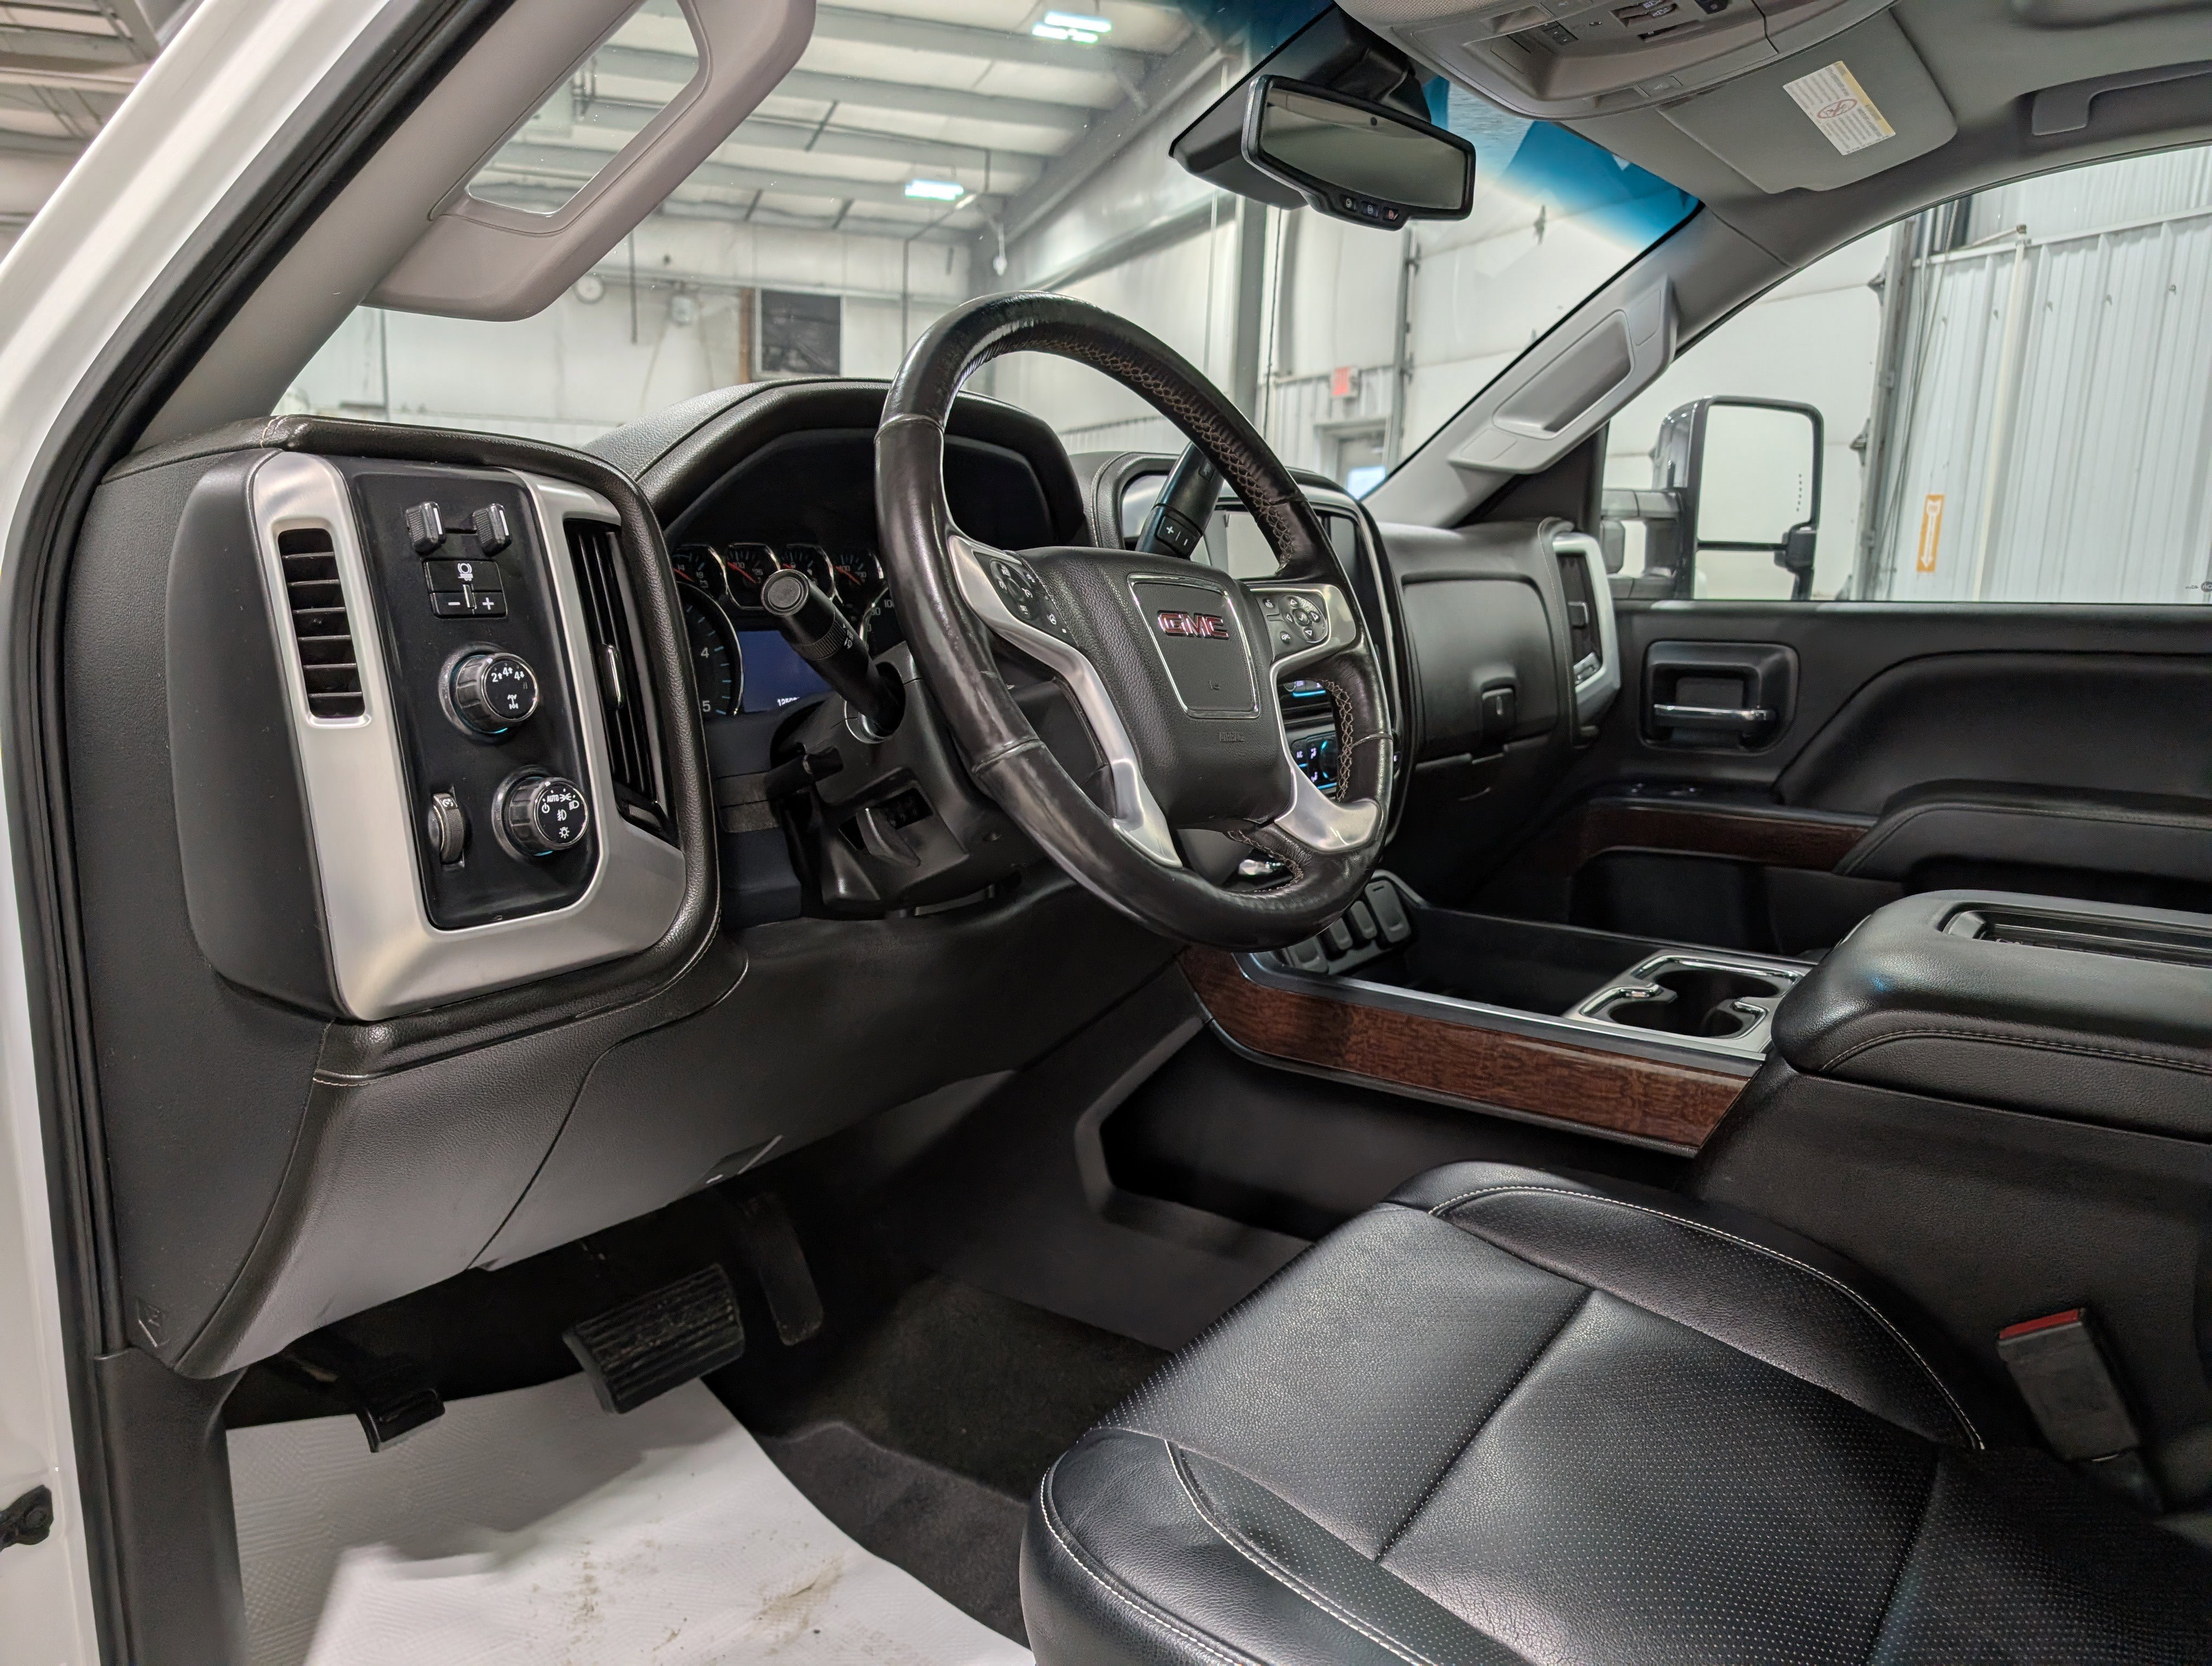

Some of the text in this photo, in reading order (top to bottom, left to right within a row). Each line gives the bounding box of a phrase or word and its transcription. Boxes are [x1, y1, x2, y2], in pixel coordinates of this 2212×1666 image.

[1157, 610, 1229, 640] GMC
[700, 647, 709, 659] 4
[702, 700, 711, 712] 5
[546, 794, 560, 803] AUTO
